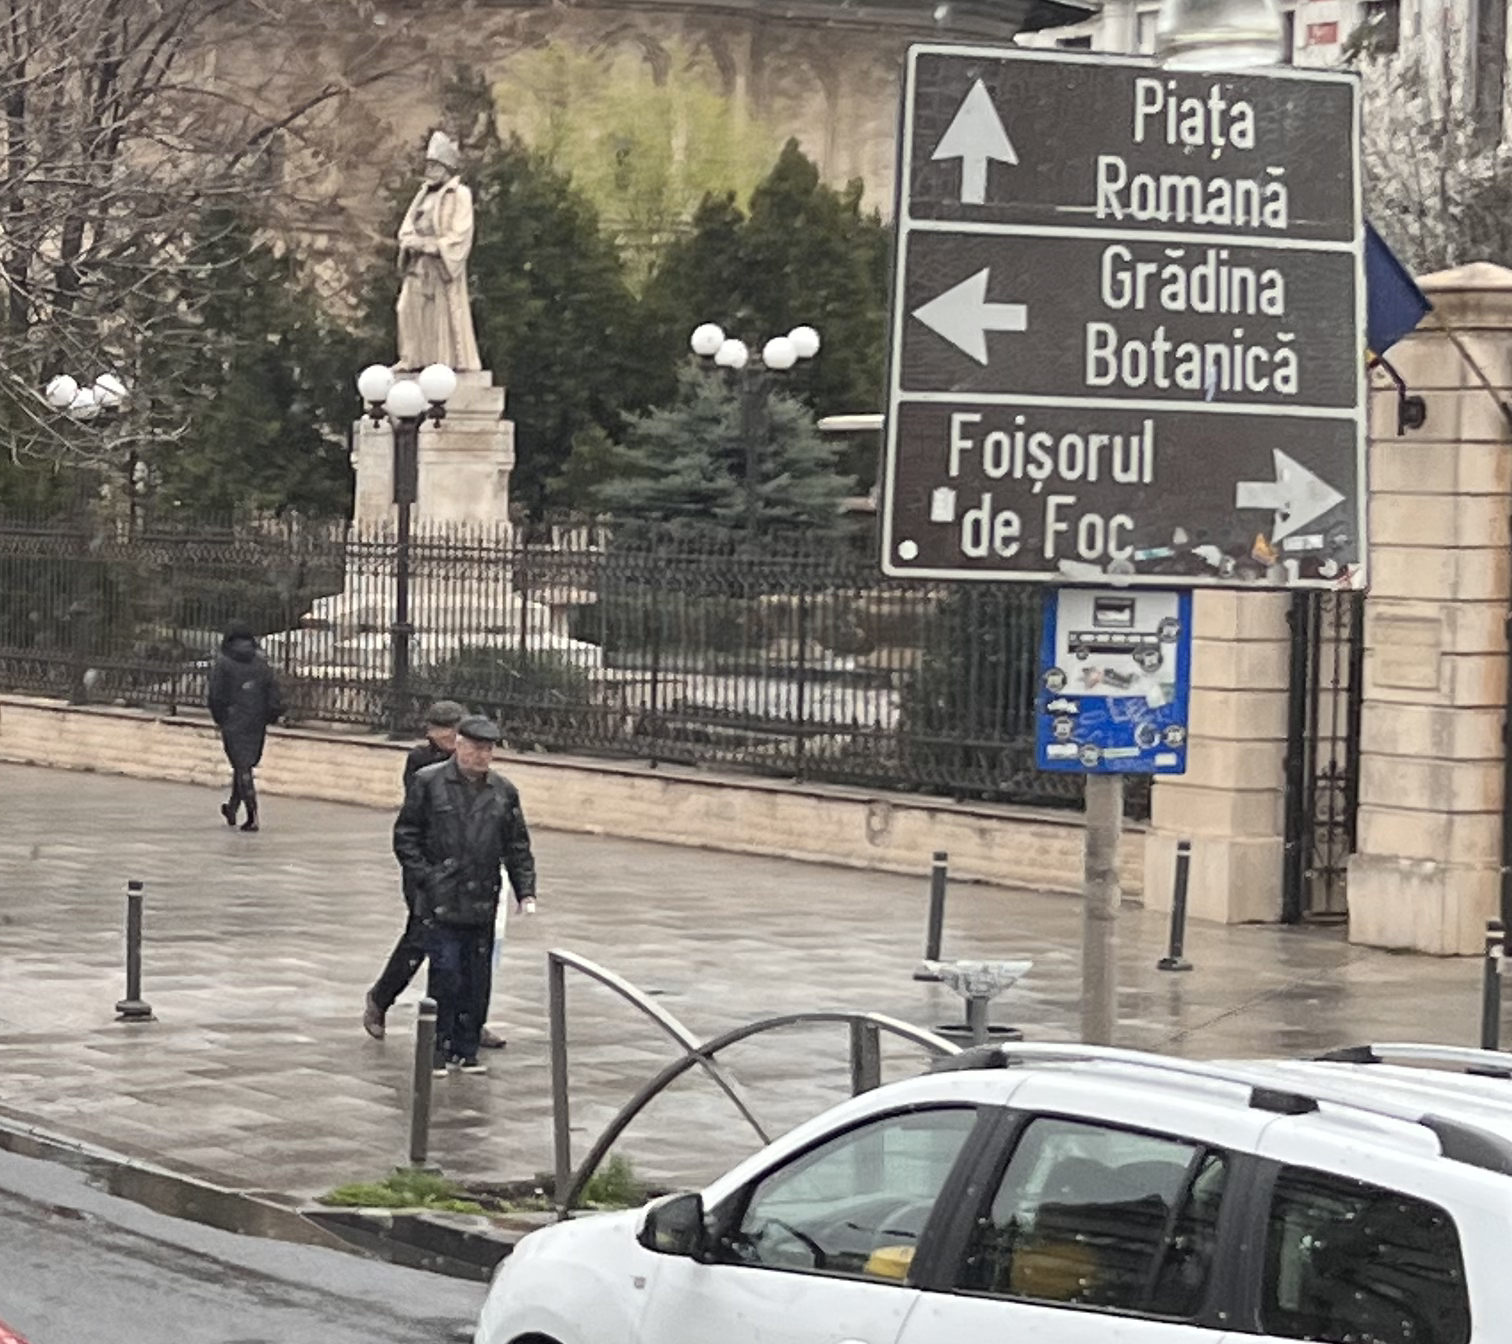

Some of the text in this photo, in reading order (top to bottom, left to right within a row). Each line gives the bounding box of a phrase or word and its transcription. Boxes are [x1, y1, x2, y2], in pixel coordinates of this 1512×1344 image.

[1133, 77, 1256, 160] Piața
[1096, 155, 1288, 229] Romană
[1101, 244, 1286, 316] Grădina
[1085, 321, 1299, 395] Botanică
[948, 412, 1155, 494] Foișorul
[961, 492, 1135, 560] de Foc
